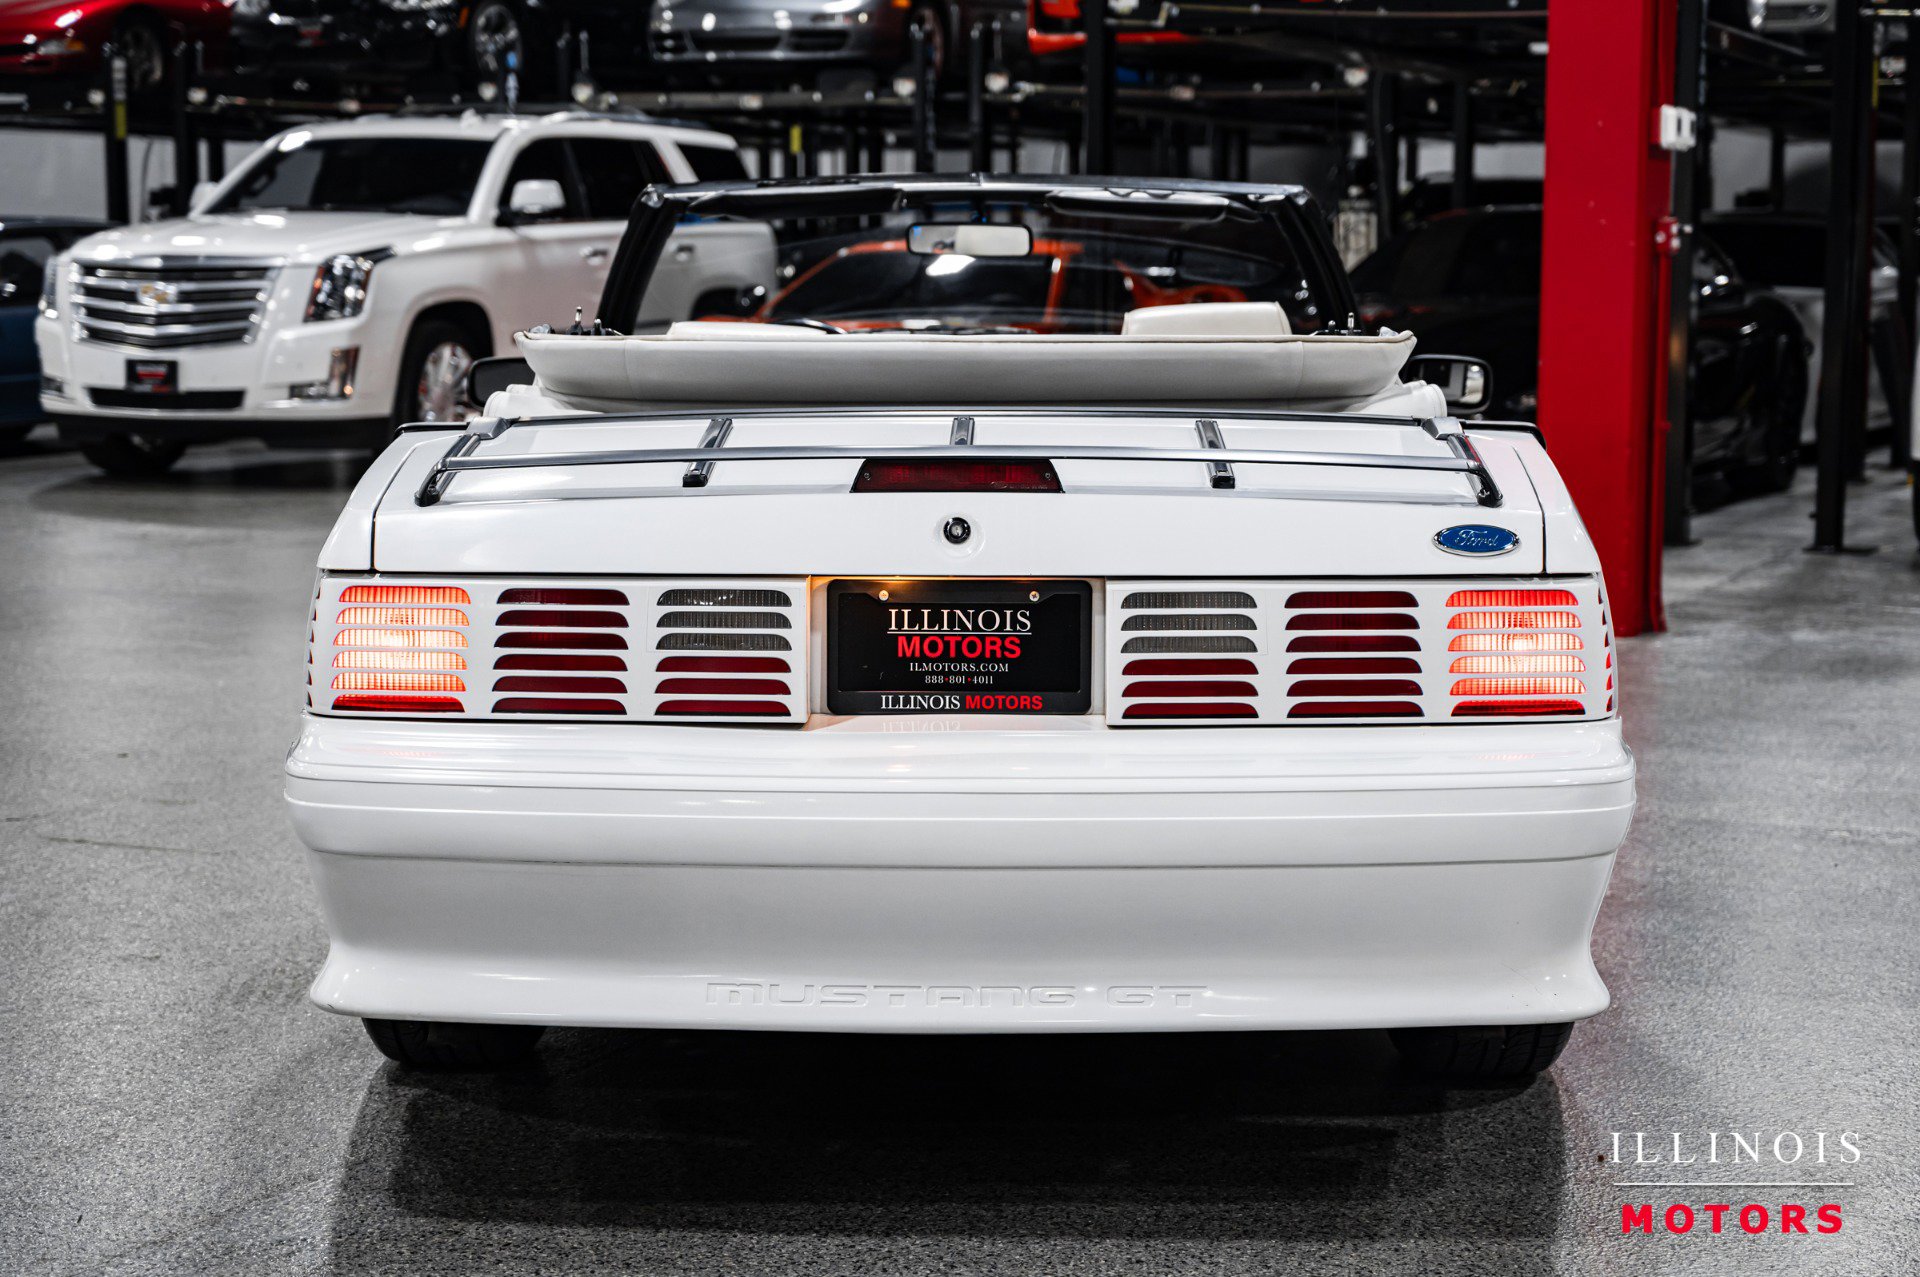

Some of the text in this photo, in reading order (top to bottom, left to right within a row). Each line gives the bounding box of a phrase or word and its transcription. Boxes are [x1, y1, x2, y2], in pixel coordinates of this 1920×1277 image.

[888, 609, 1031, 631] ILLINOIS
[897, 636, 1021, 658] MOTORS
[910, 662, 1009, 672] ILMOTORS.COM
[881, 695, 1043, 710] ILLINOIS MOTORS
[706, 983, 1208, 1008] MUSTANG GT
